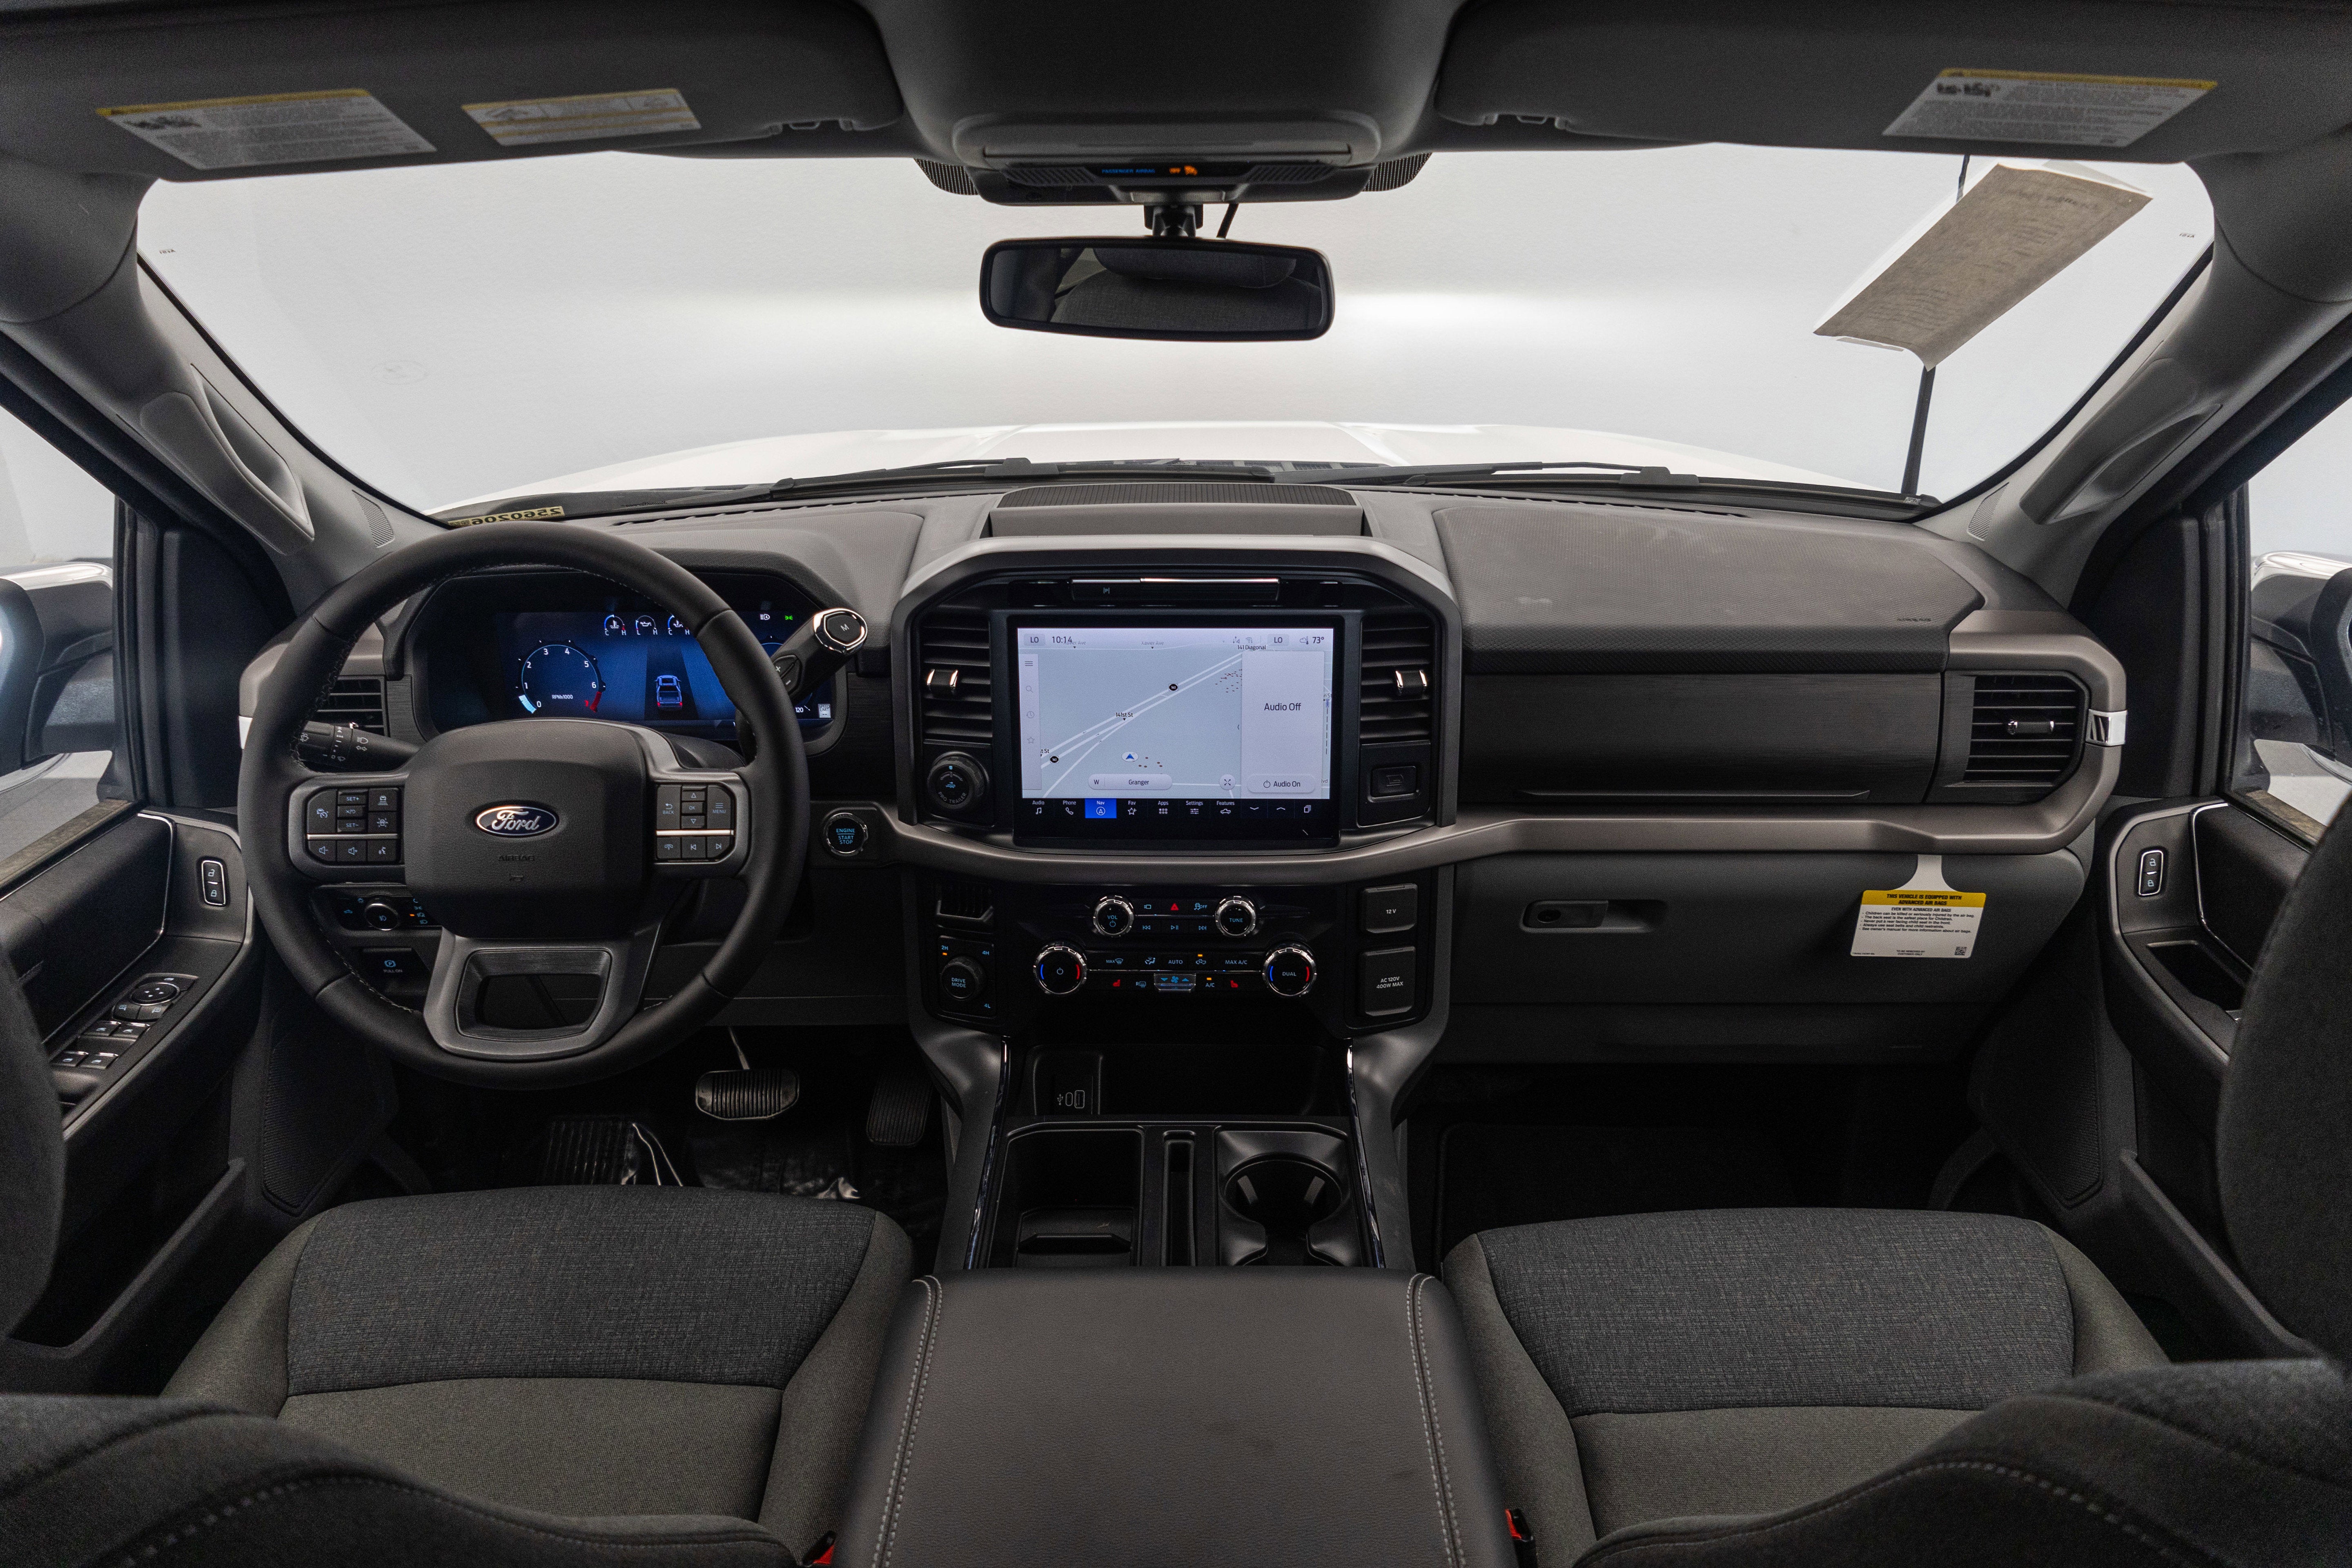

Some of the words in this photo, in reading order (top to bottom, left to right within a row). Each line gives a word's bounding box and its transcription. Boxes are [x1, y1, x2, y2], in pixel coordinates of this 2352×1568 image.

[938, 792, 947, 801] PRO
[949, 793, 967, 804] TRAILER
[491, 810, 541, 831] Ford
